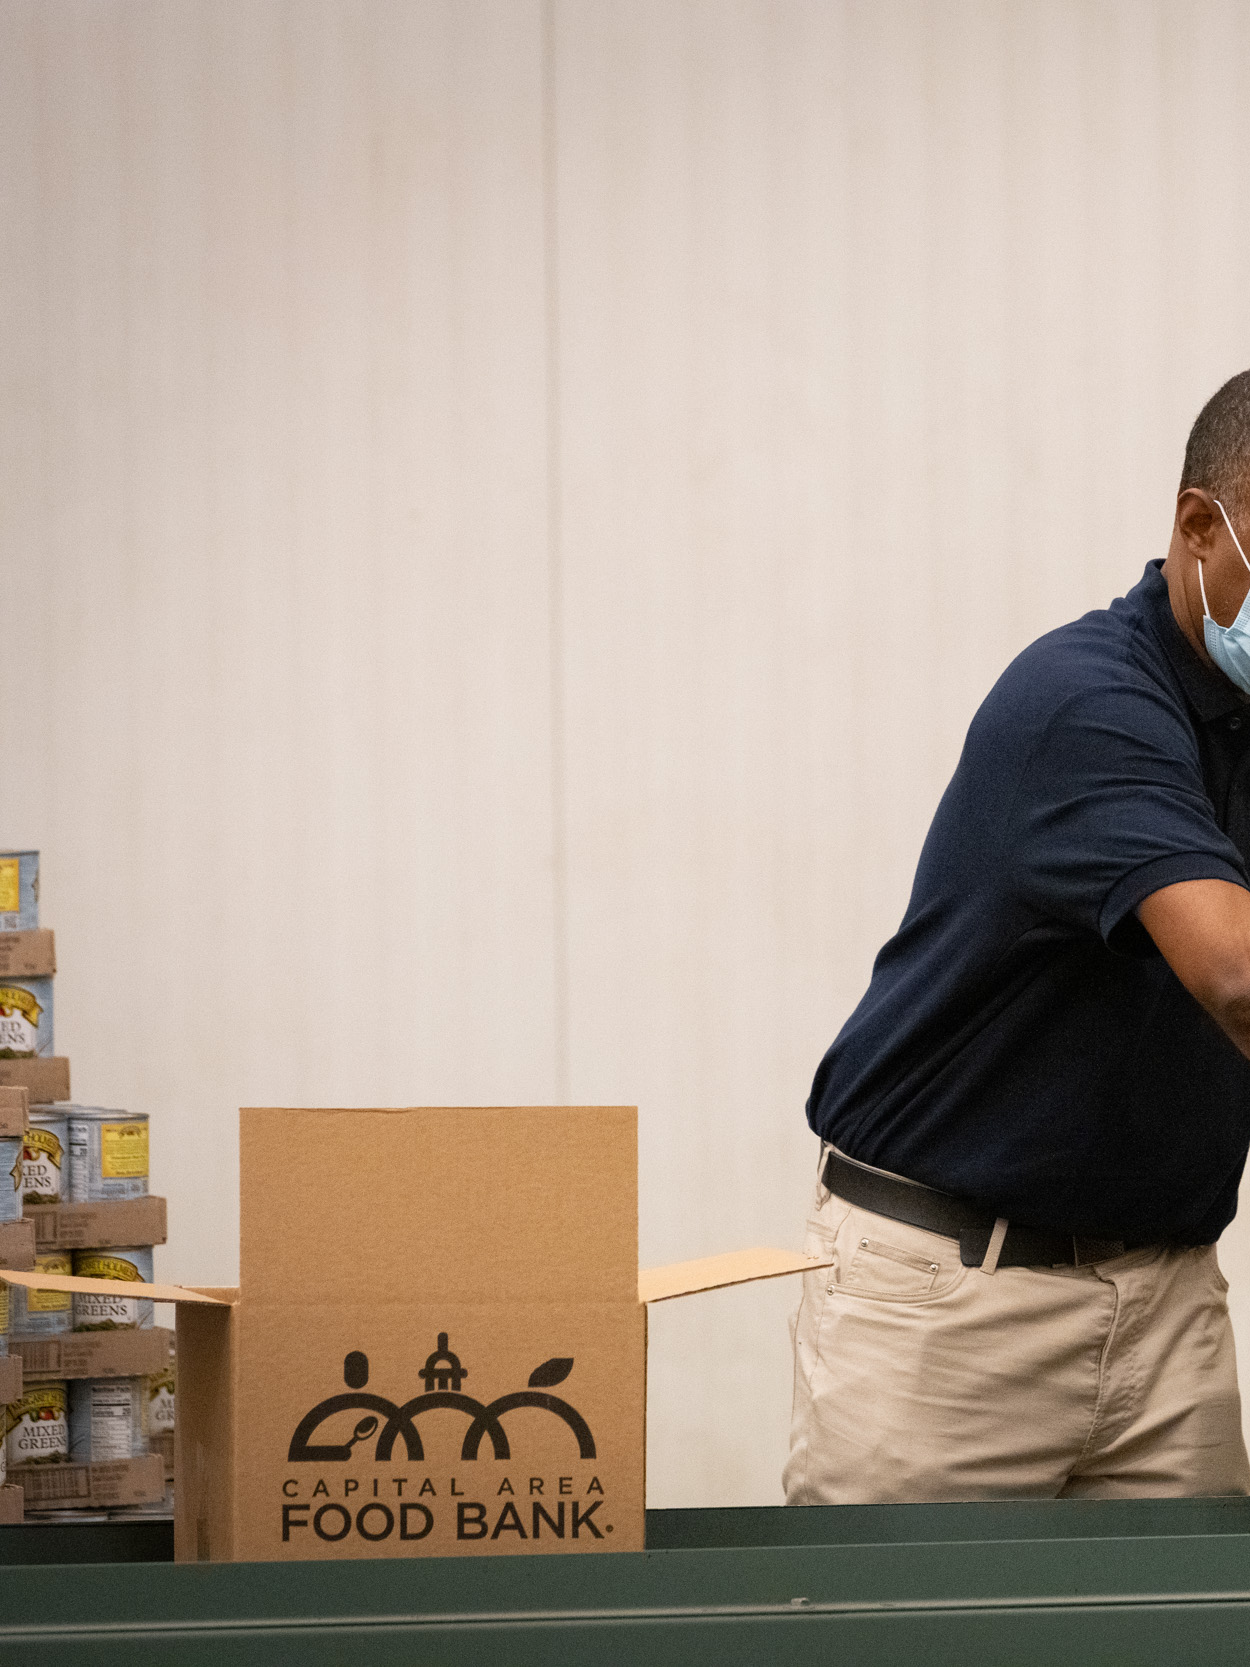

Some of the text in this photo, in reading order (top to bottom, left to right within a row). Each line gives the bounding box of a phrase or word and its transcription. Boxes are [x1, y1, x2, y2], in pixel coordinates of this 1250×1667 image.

[75, 1304, 128, 1317] GREENS
[282, 1476, 605, 1498] CAPITAL AREA
[281, 1502, 434, 1542] FOOD
